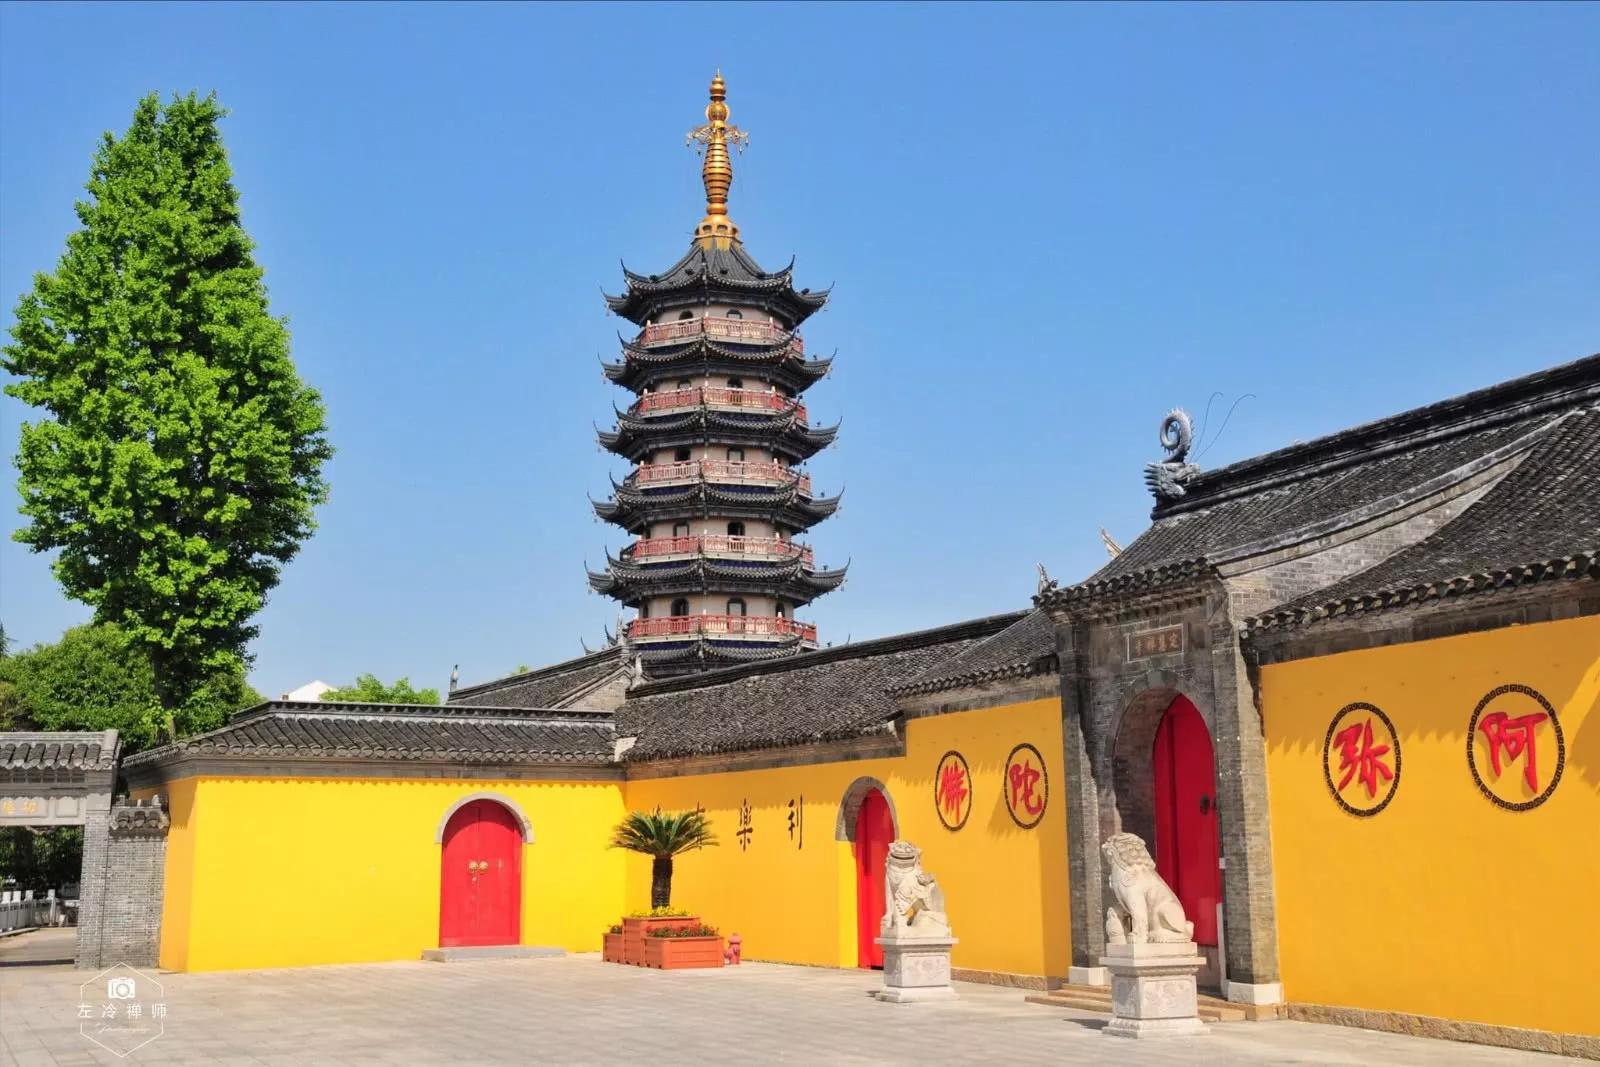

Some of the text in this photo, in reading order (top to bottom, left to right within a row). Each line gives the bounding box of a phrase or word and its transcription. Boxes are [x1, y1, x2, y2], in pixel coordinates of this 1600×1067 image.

[1478, 711, 1548, 794] 阿
[1009, 758, 1043, 815] 陀
[787, 792, 803, 850] 利
